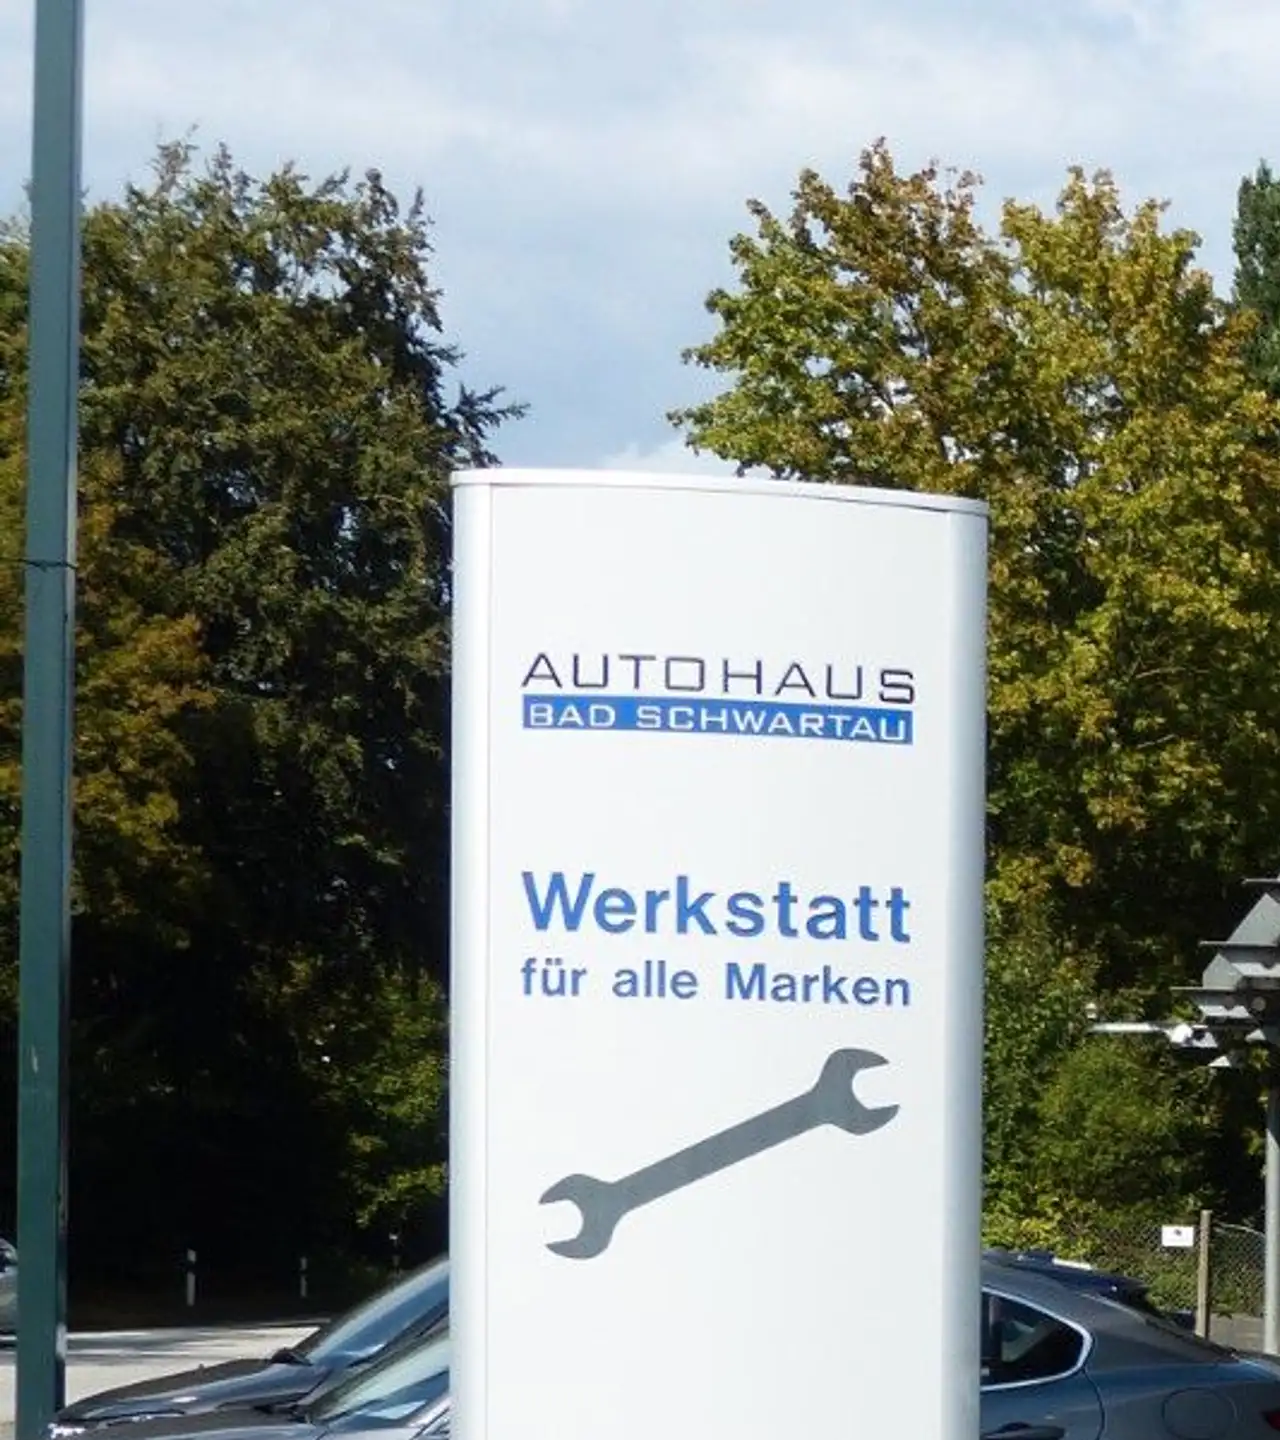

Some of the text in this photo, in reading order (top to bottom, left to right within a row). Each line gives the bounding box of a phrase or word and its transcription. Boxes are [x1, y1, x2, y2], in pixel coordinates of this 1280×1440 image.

[521, 652, 916, 704] AUTOHAUS
[529, 703, 906, 742] BAD SCHWARTAU
[521, 871, 912, 943] Werkstatt
[521, 957, 911, 1006] für alle Marken
